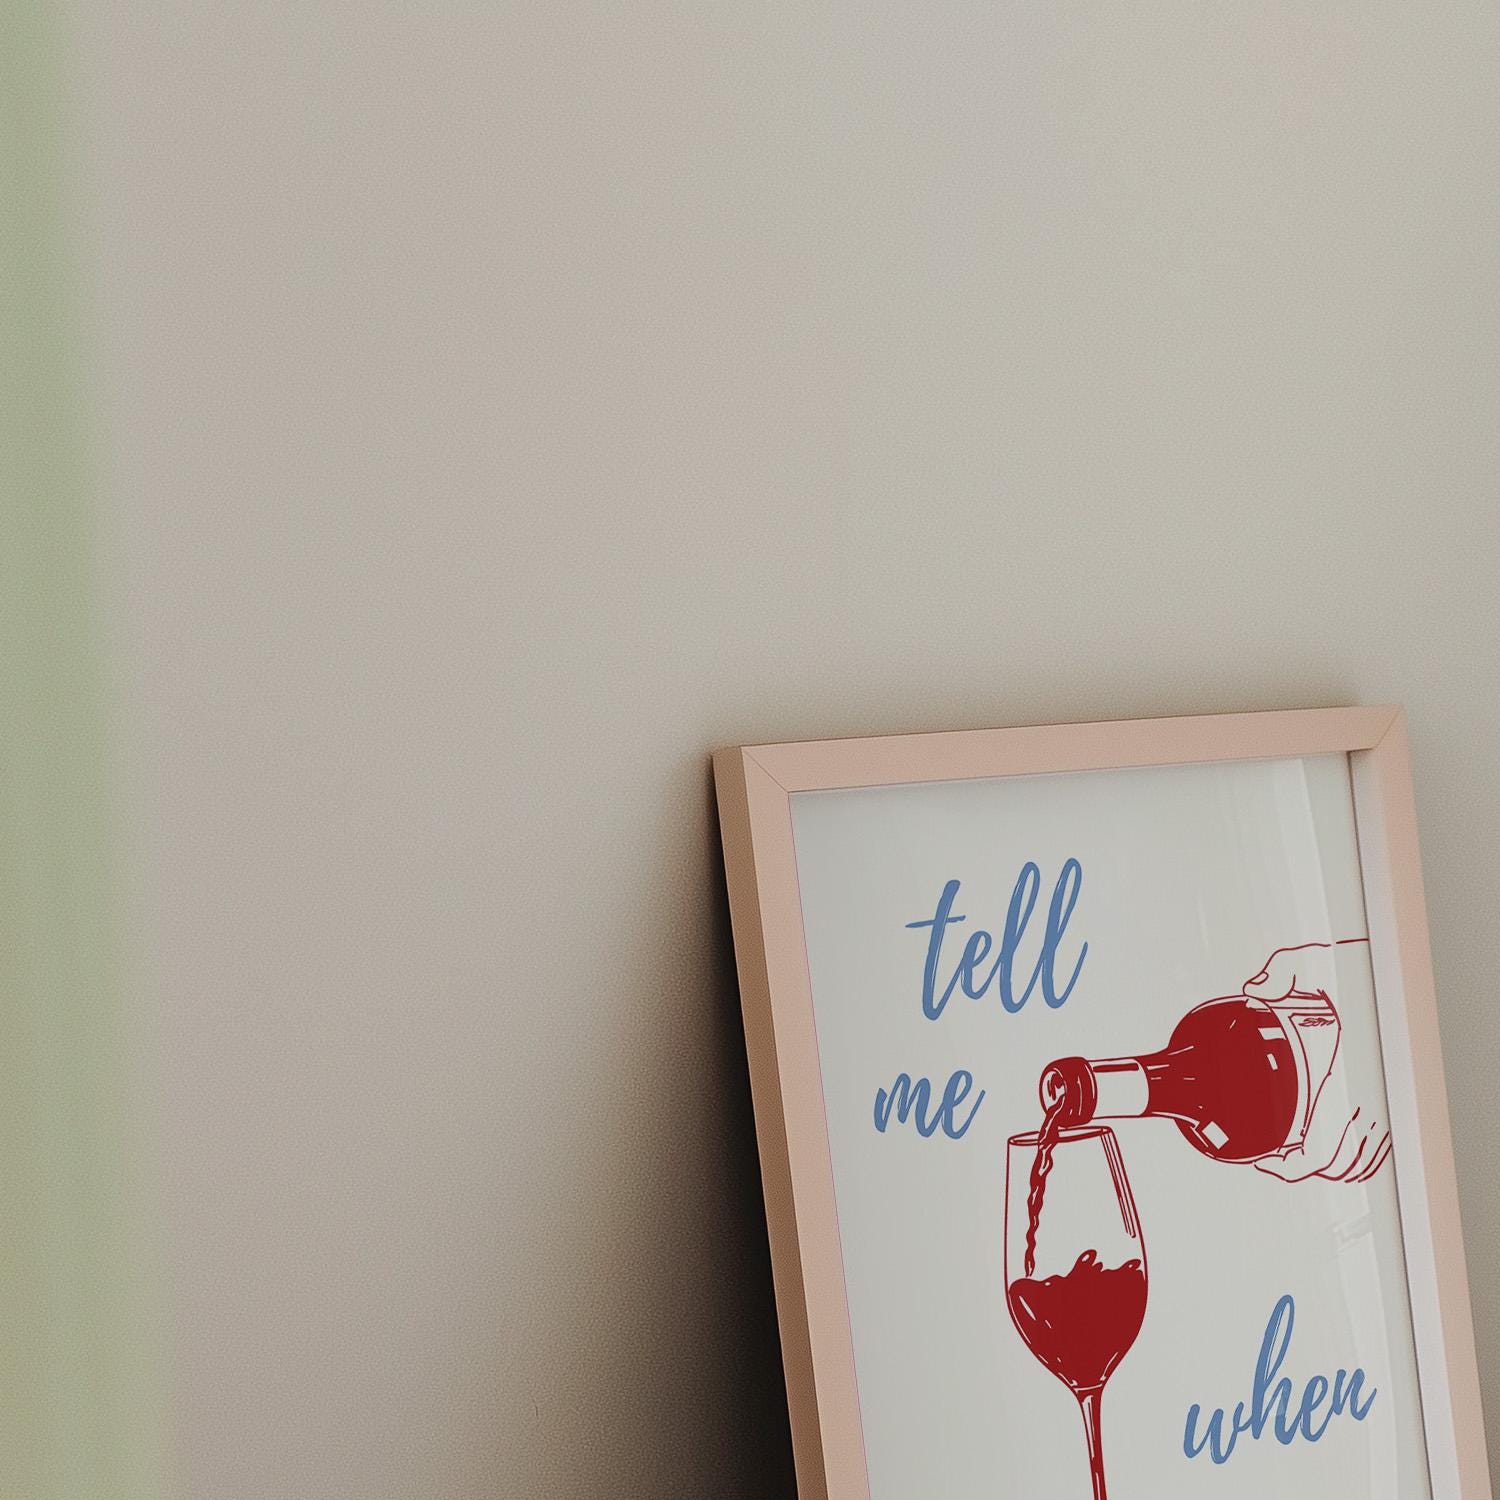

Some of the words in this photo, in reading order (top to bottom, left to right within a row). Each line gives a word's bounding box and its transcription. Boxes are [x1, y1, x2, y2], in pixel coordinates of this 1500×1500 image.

[905, 857, 1089, 1021] tell
[874, 1069, 986, 1140] me
[1183, 1294, 1377, 1465] when
